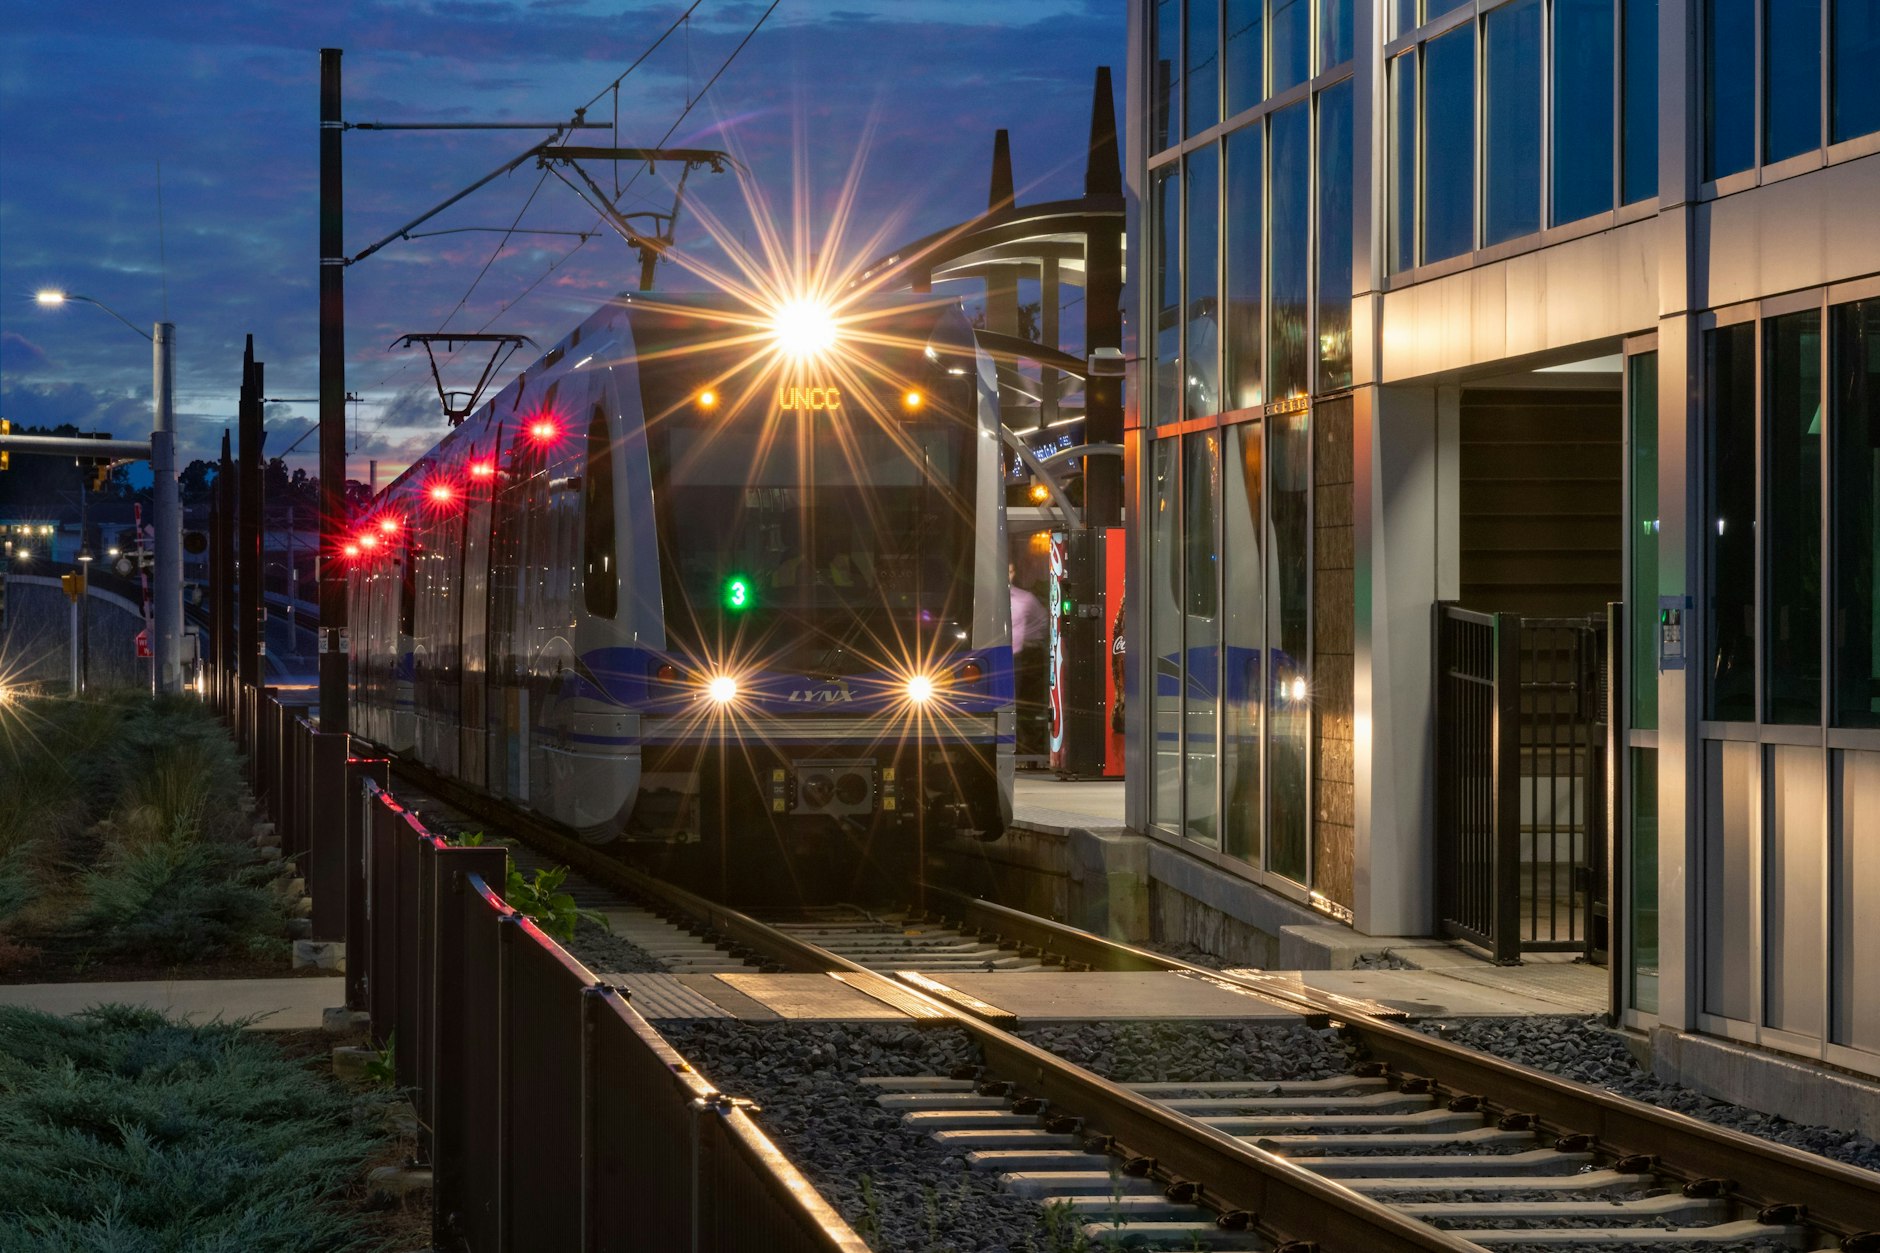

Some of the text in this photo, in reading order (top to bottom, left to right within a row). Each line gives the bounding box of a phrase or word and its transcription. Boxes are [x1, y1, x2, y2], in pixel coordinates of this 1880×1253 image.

[779, 387, 840, 410] UNCC
[731, 581, 745, 605] 3
[788, 690, 858, 702] LYNX
